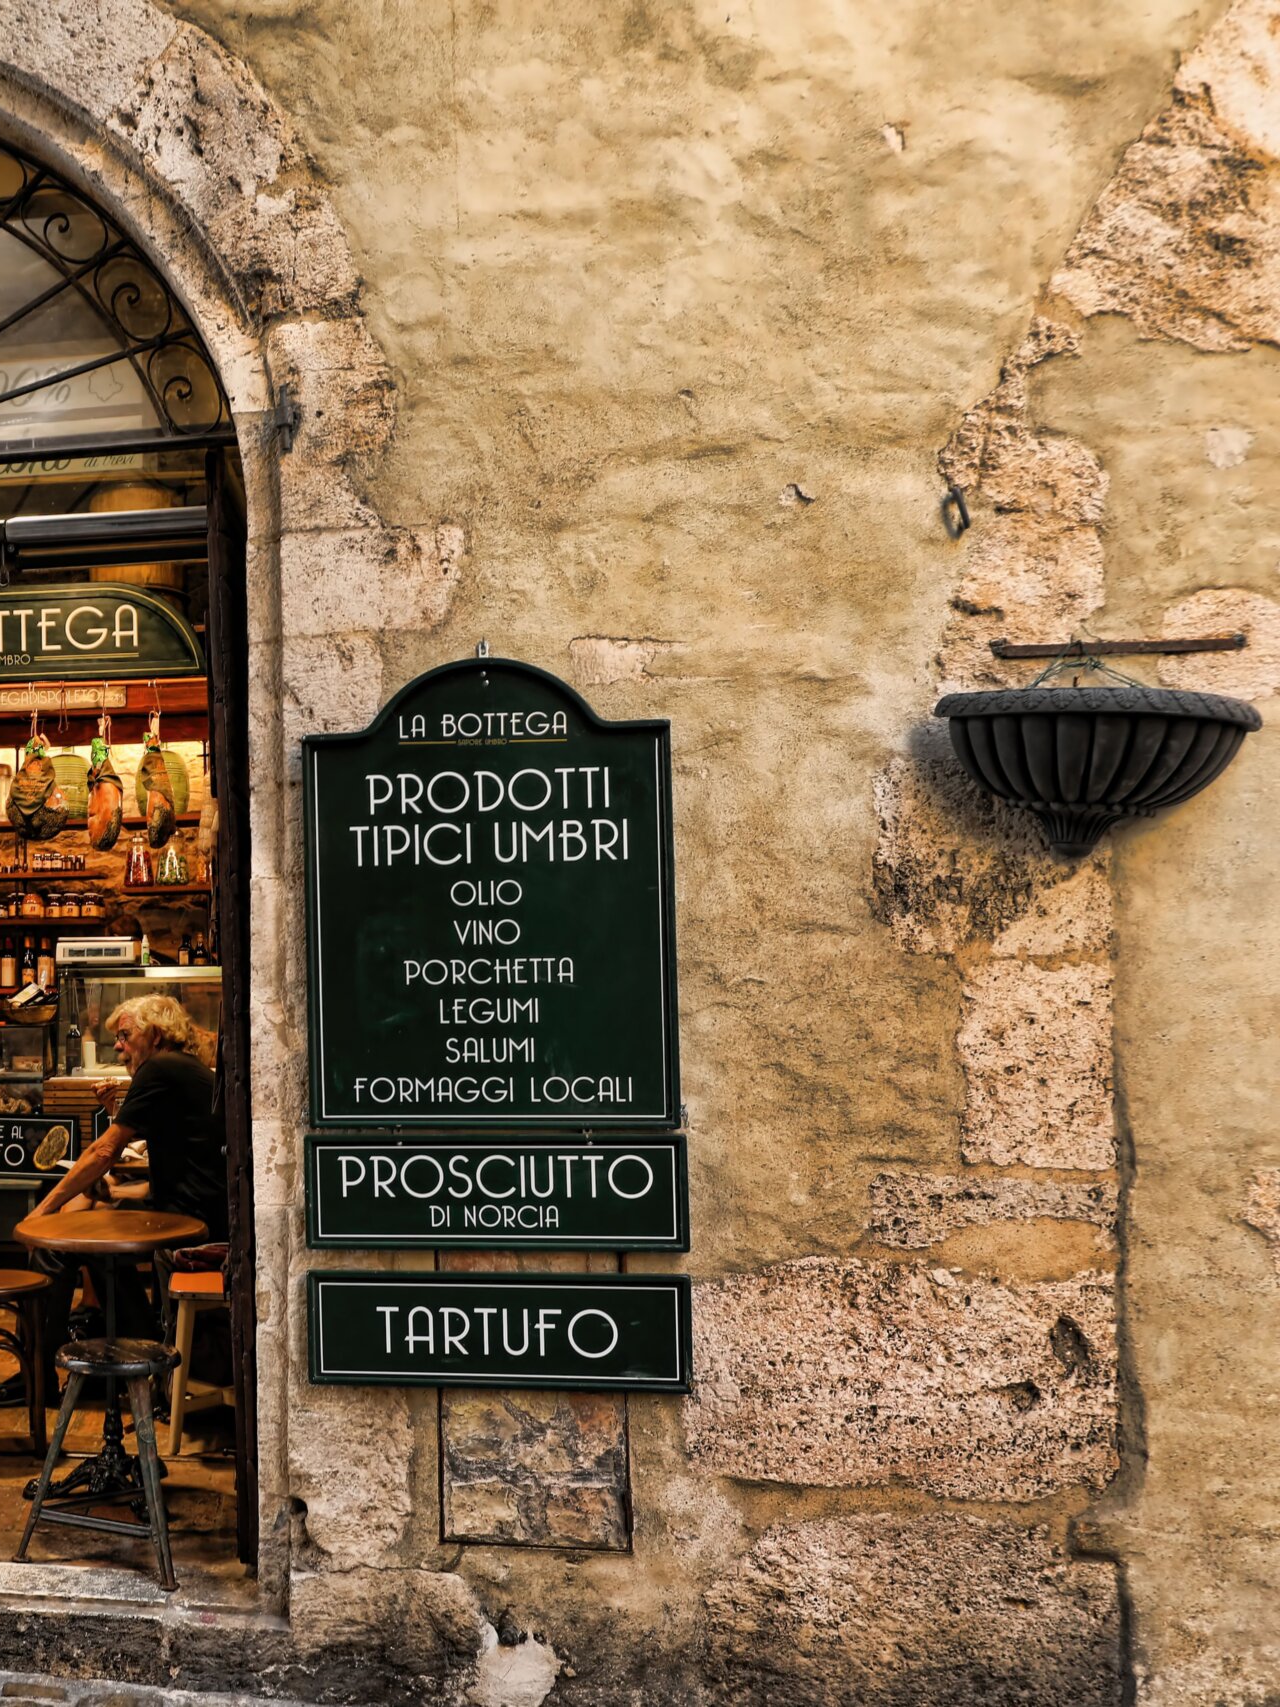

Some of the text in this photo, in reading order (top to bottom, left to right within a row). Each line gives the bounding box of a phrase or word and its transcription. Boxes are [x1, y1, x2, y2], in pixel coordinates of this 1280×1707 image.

[398, 711, 568, 739] LA BOTTEGA
[365, 766, 610, 815] PRODOTTI
[349, 818, 629, 867] TIPICI UMBRI
[450, 879, 522, 906] OLIO
[453, 919, 520, 945] VINO
[403, 957, 574, 985] PORCHETTA
[439, 998, 539, 1024] LEGUMI
[445, 1037, 536, 1063] SALUMI
[353, 1076, 633, 1103] FORMAGGI LOCALI
[11, 1125, 24, 1140] AL
[337, 1154, 654, 1199] PROSCIUTTO
[429, 1204, 560, 1229] DI NORCIA
[376, 1306, 618, 1359] TARTUFO
